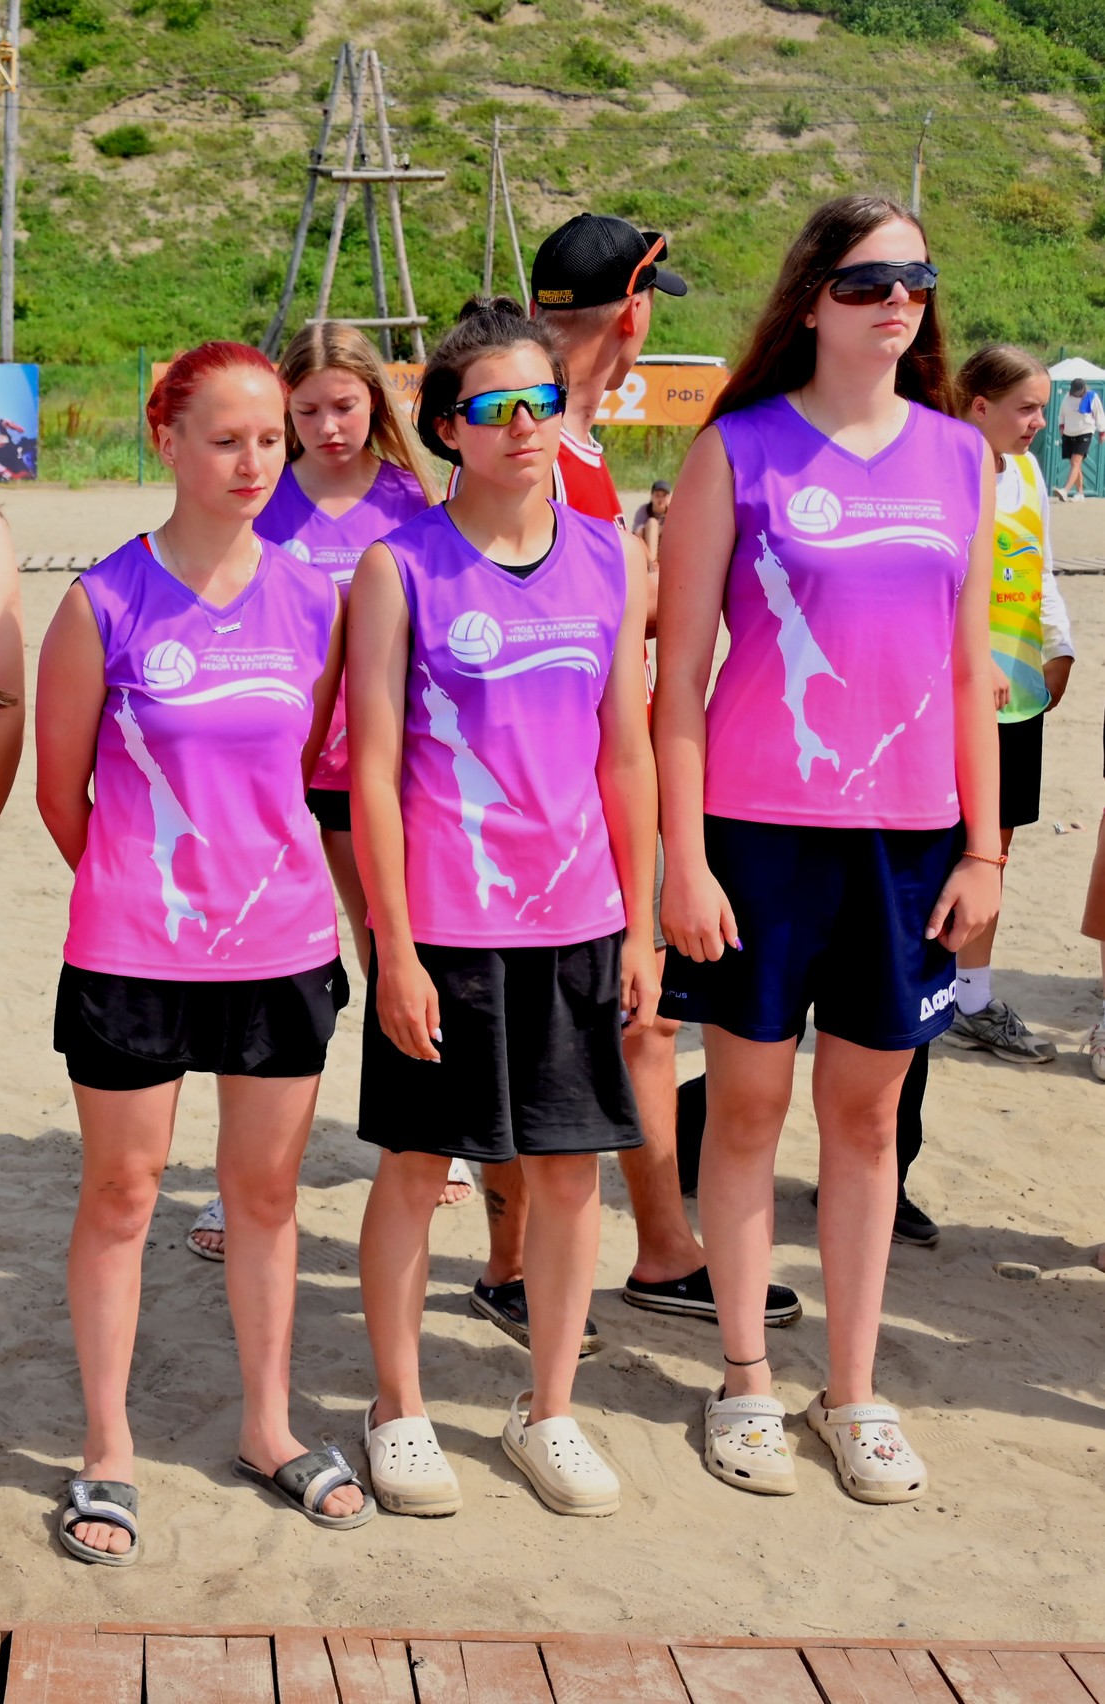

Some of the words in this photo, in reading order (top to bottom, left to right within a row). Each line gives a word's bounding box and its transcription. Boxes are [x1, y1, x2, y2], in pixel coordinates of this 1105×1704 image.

[667, 389, 704, 401] РФБ
[996, 592, 1026, 604] EMCO
[75, 1484, 88, 1508] SPORT
